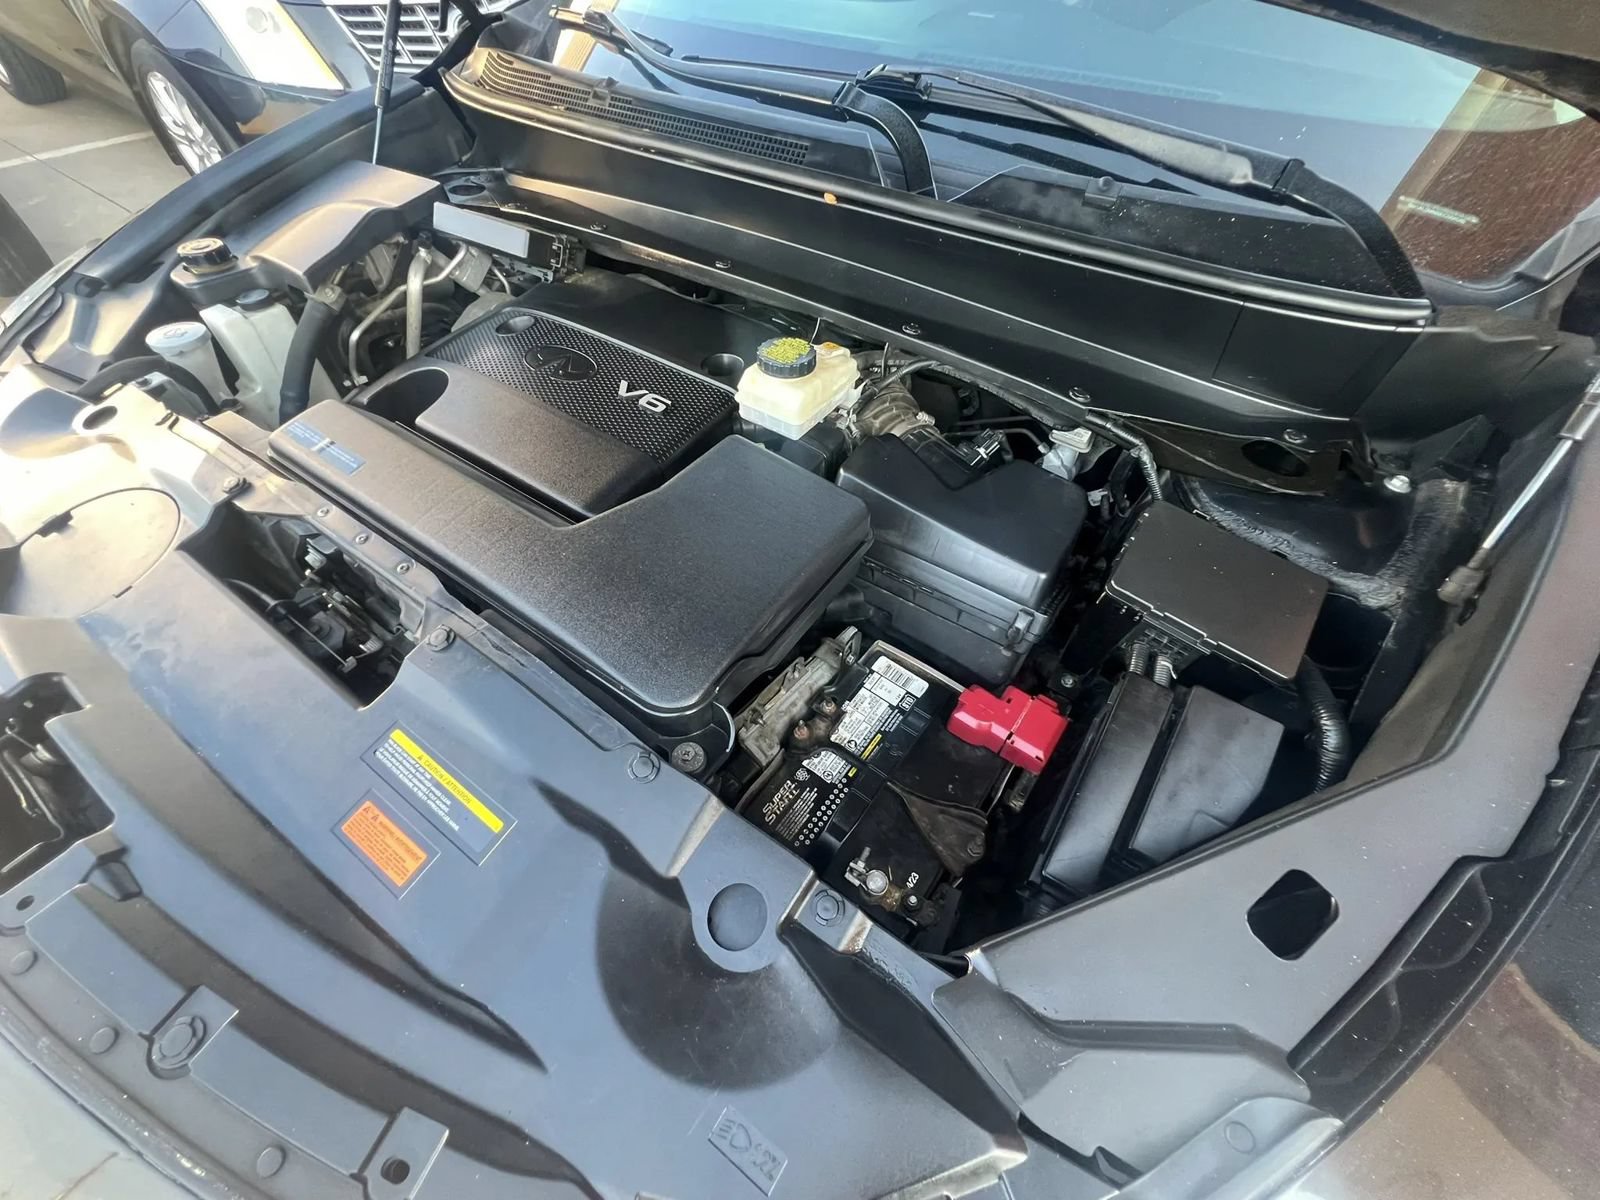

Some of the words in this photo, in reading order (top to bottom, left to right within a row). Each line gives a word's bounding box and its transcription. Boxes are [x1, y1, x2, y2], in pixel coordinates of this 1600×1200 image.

[618, 379, 672, 414] V6
[901, 696, 914, 709] STD
[423, 759, 444, 779] CAUTION
[444, 779, 471, 804] ATTENTION
[763, 780, 792, 813] SUPER
[765, 784, 800, 825] START
